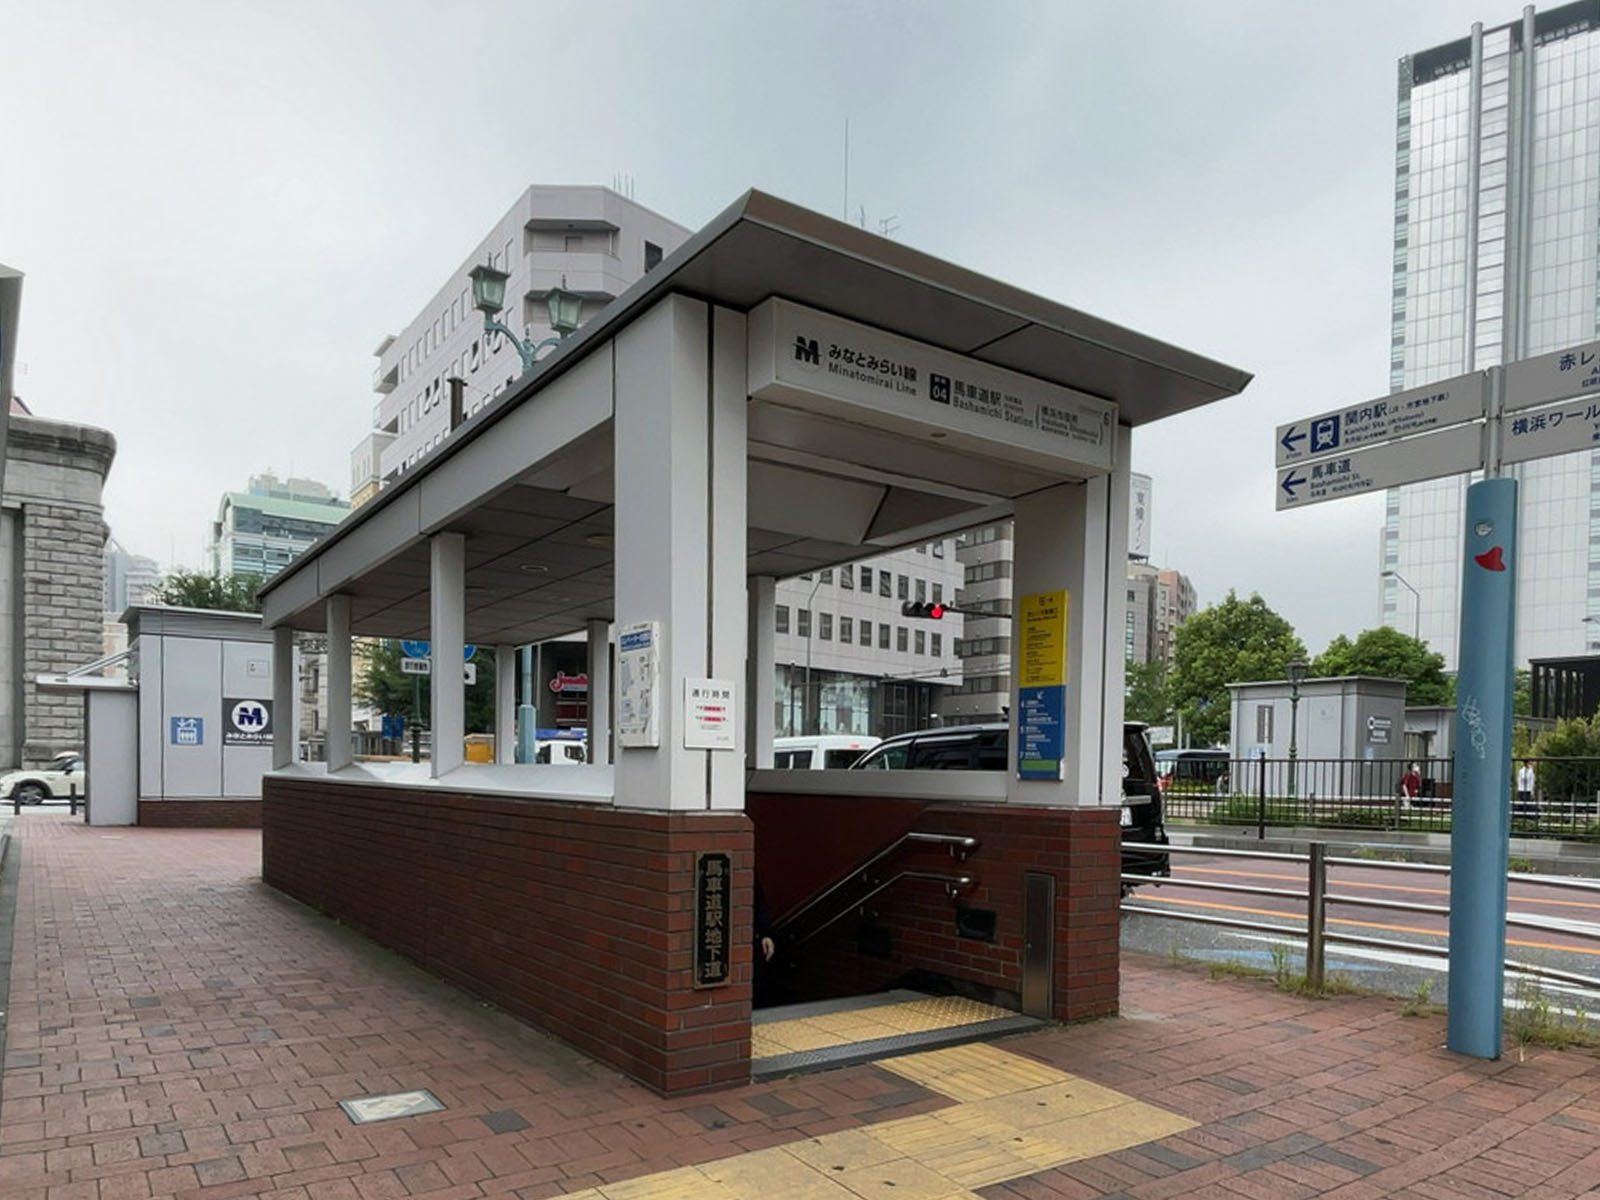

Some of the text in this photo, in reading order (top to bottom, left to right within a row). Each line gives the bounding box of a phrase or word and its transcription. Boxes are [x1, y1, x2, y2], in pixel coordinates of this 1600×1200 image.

[828, 344, 917, 381] みなとみらい線
[828, 362, 917, 396] Minatomirai Line
[932, 385, 948, 401] 04
[953, 380, 1002, 406] 馬車道駅
[953, 396, 1003, 420] Bashamichi
[1004, 410, 1034, 428] Station
[1345, 402, 1388, 427] 関内駅
[1311, 459, 1351, 480] 馬車道
